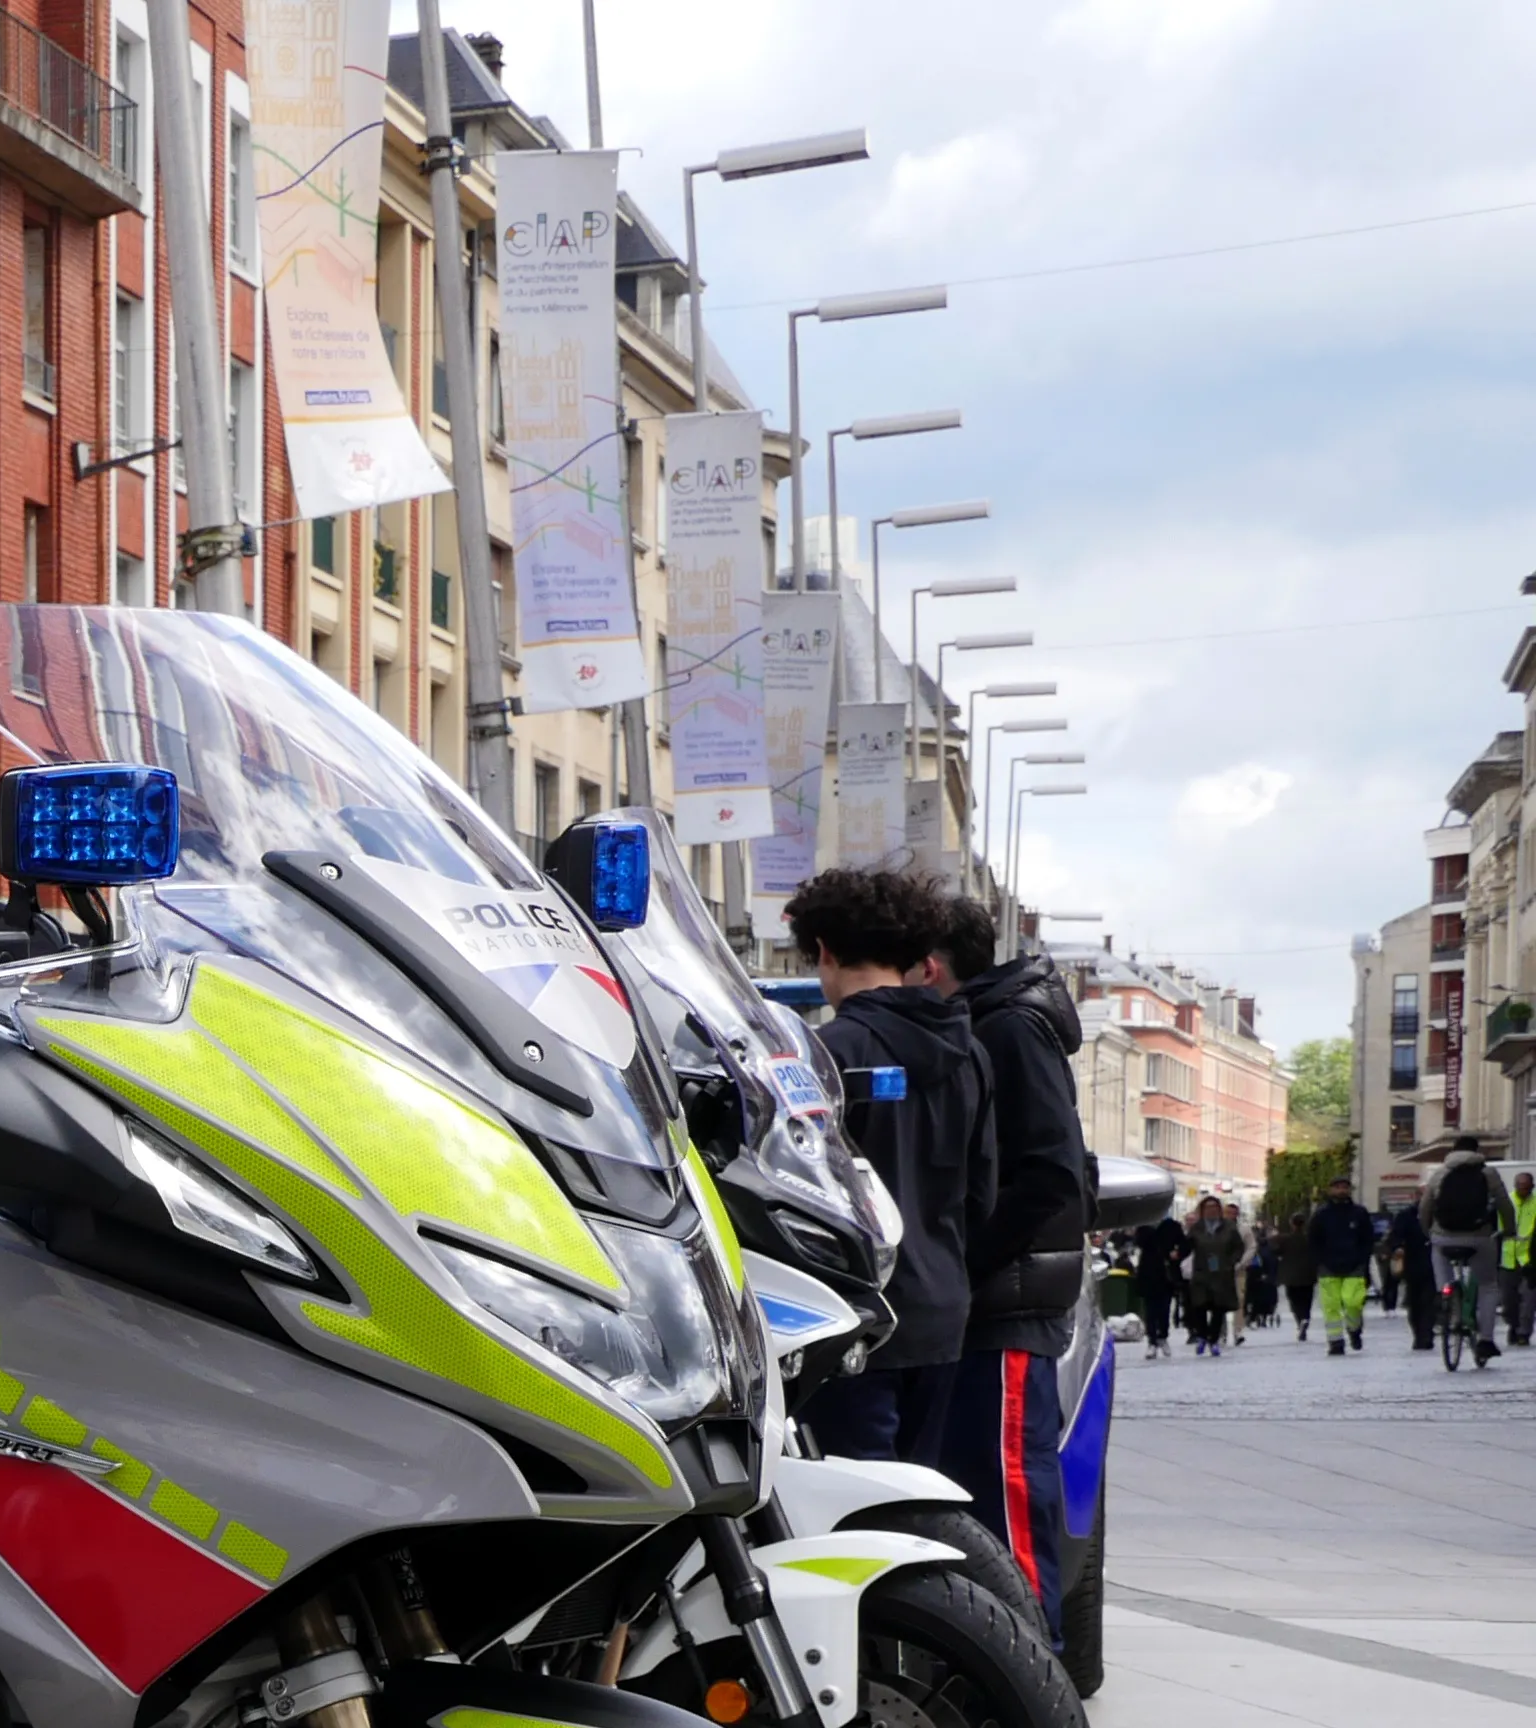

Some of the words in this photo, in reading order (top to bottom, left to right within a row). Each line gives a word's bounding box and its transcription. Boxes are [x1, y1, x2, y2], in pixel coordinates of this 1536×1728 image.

[503, 210, 609, 257] CIAP
[671, 457, 757, 494] CIAP
[442, 902, 571, 935] POLICE
[464, 930, 586, 954] NATIONALE
